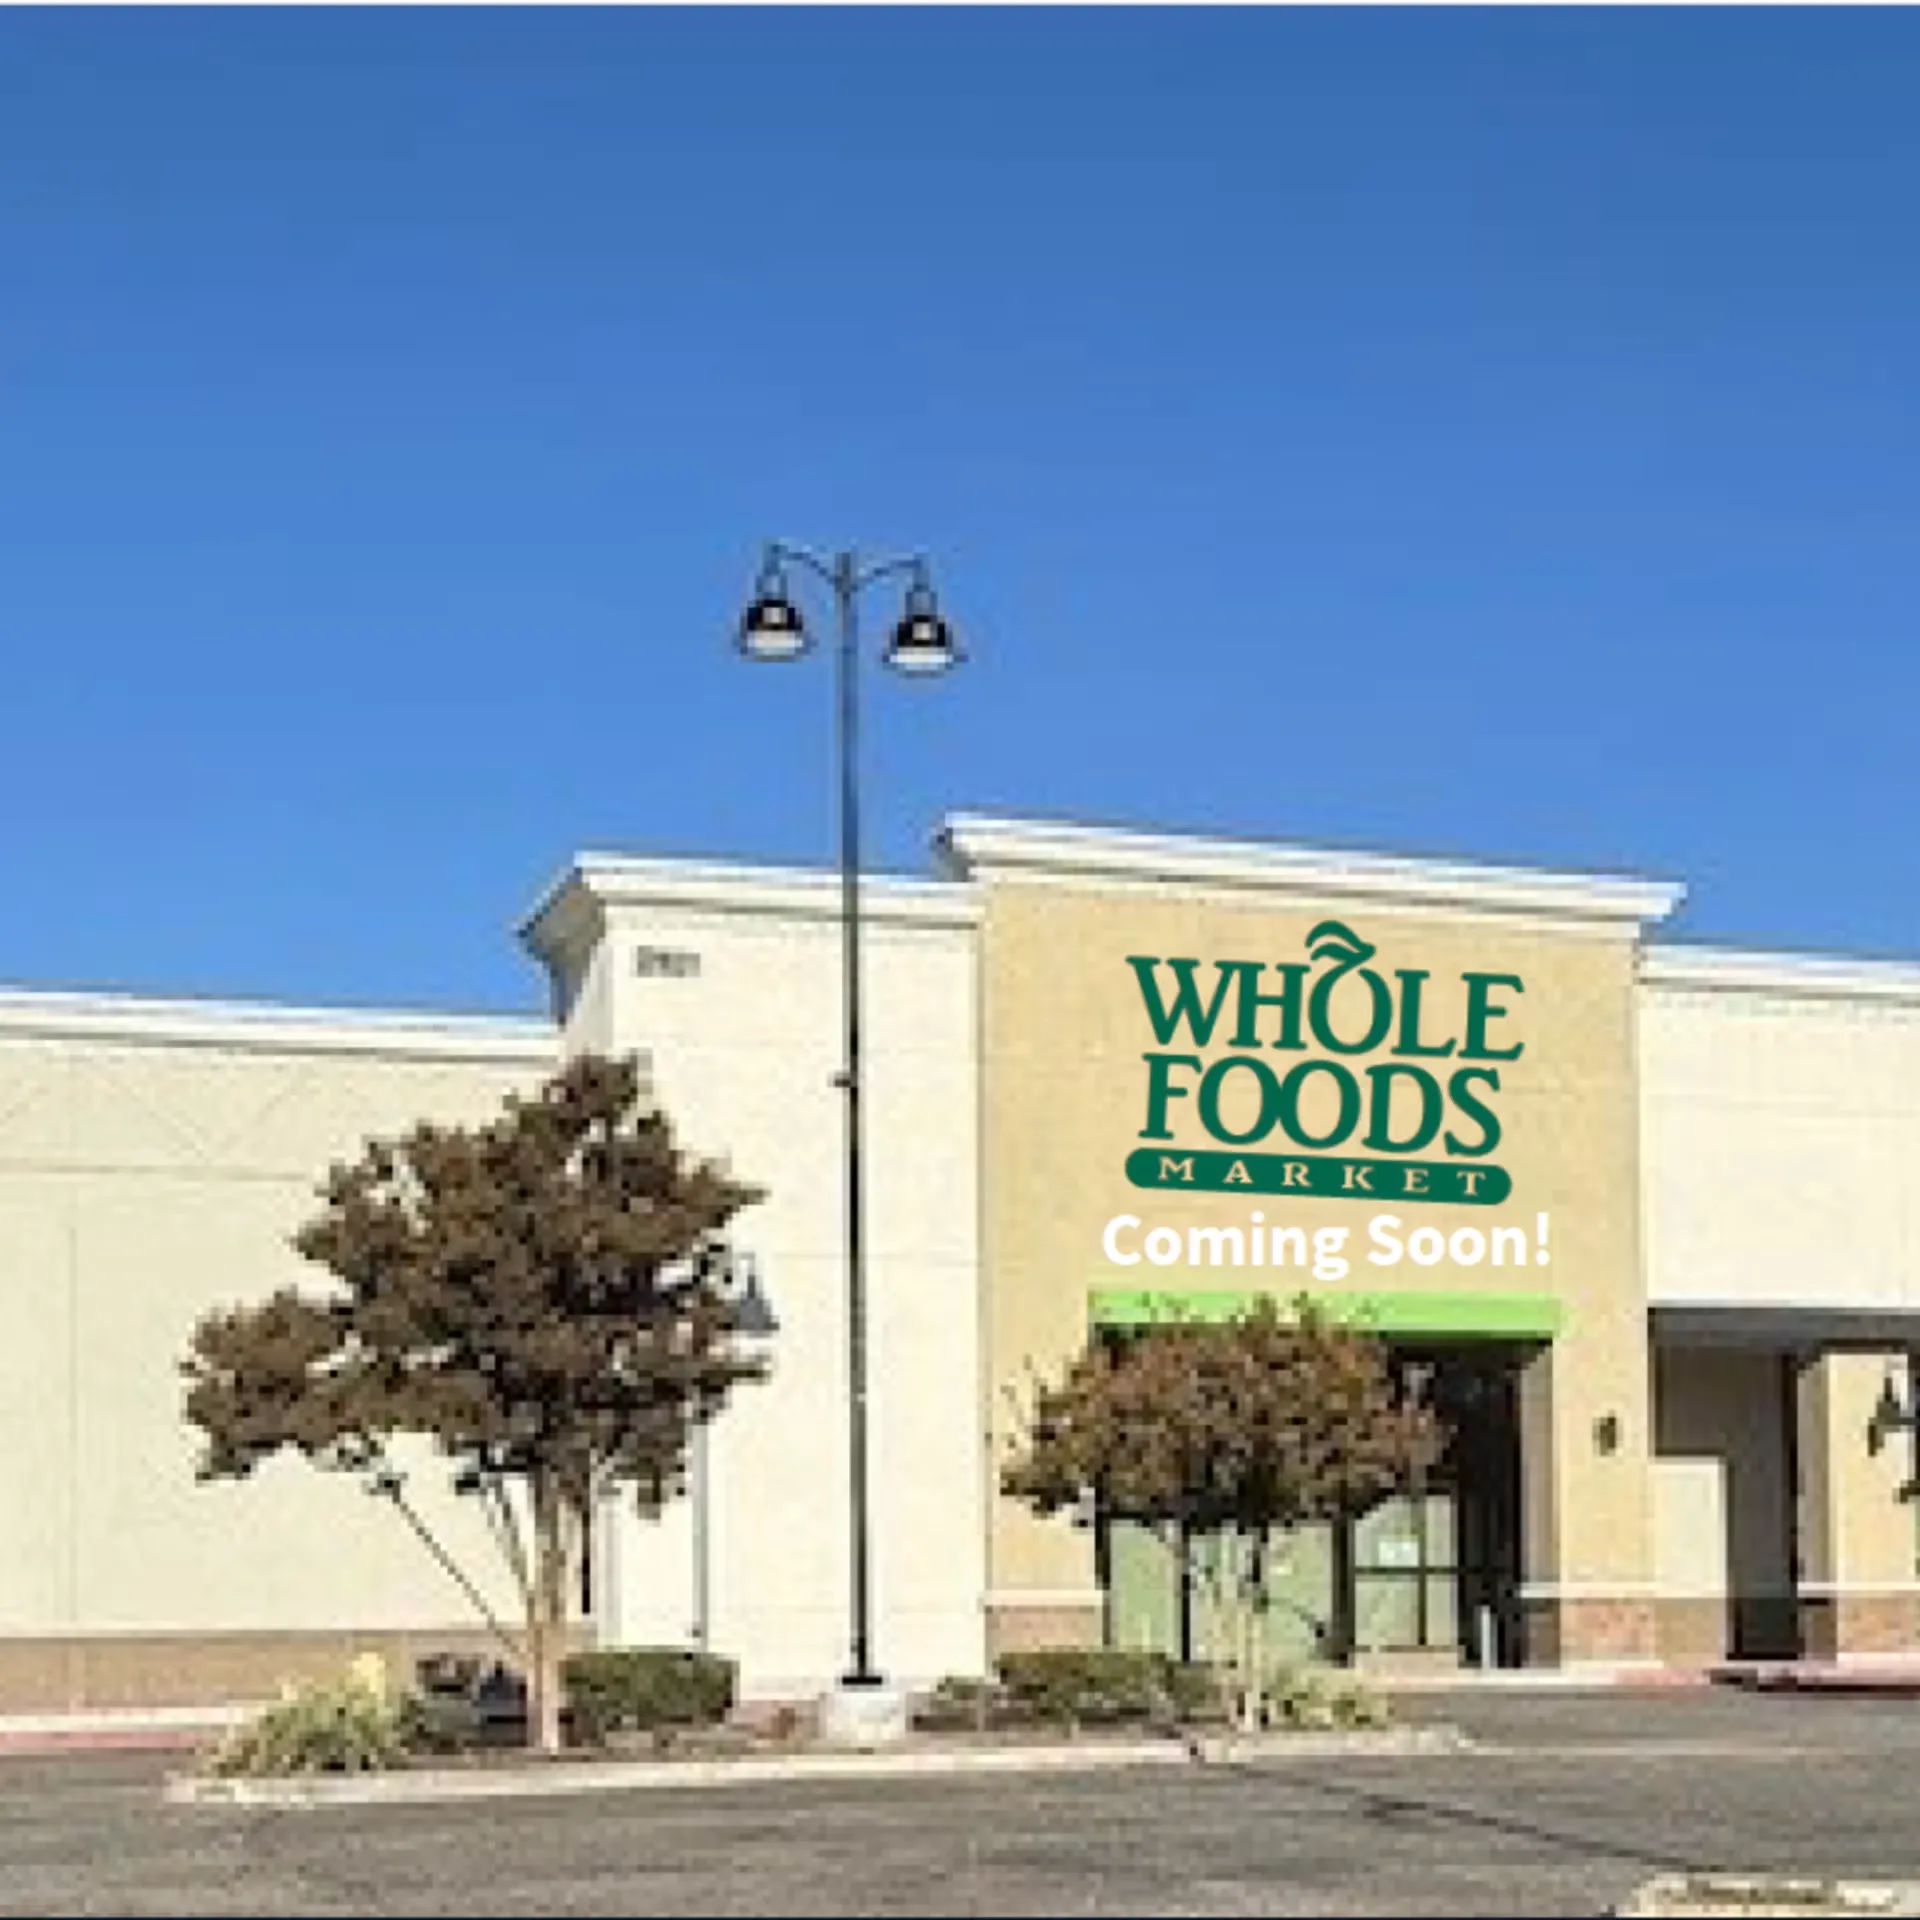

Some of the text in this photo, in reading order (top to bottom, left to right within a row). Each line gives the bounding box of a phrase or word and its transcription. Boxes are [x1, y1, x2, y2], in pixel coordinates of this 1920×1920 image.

[1124, 954, 1525, 1061] WHOLE
[1137, 1052, 1502, 1158] FOODS
[1157, 1156, 1487, 1197] MARKET
